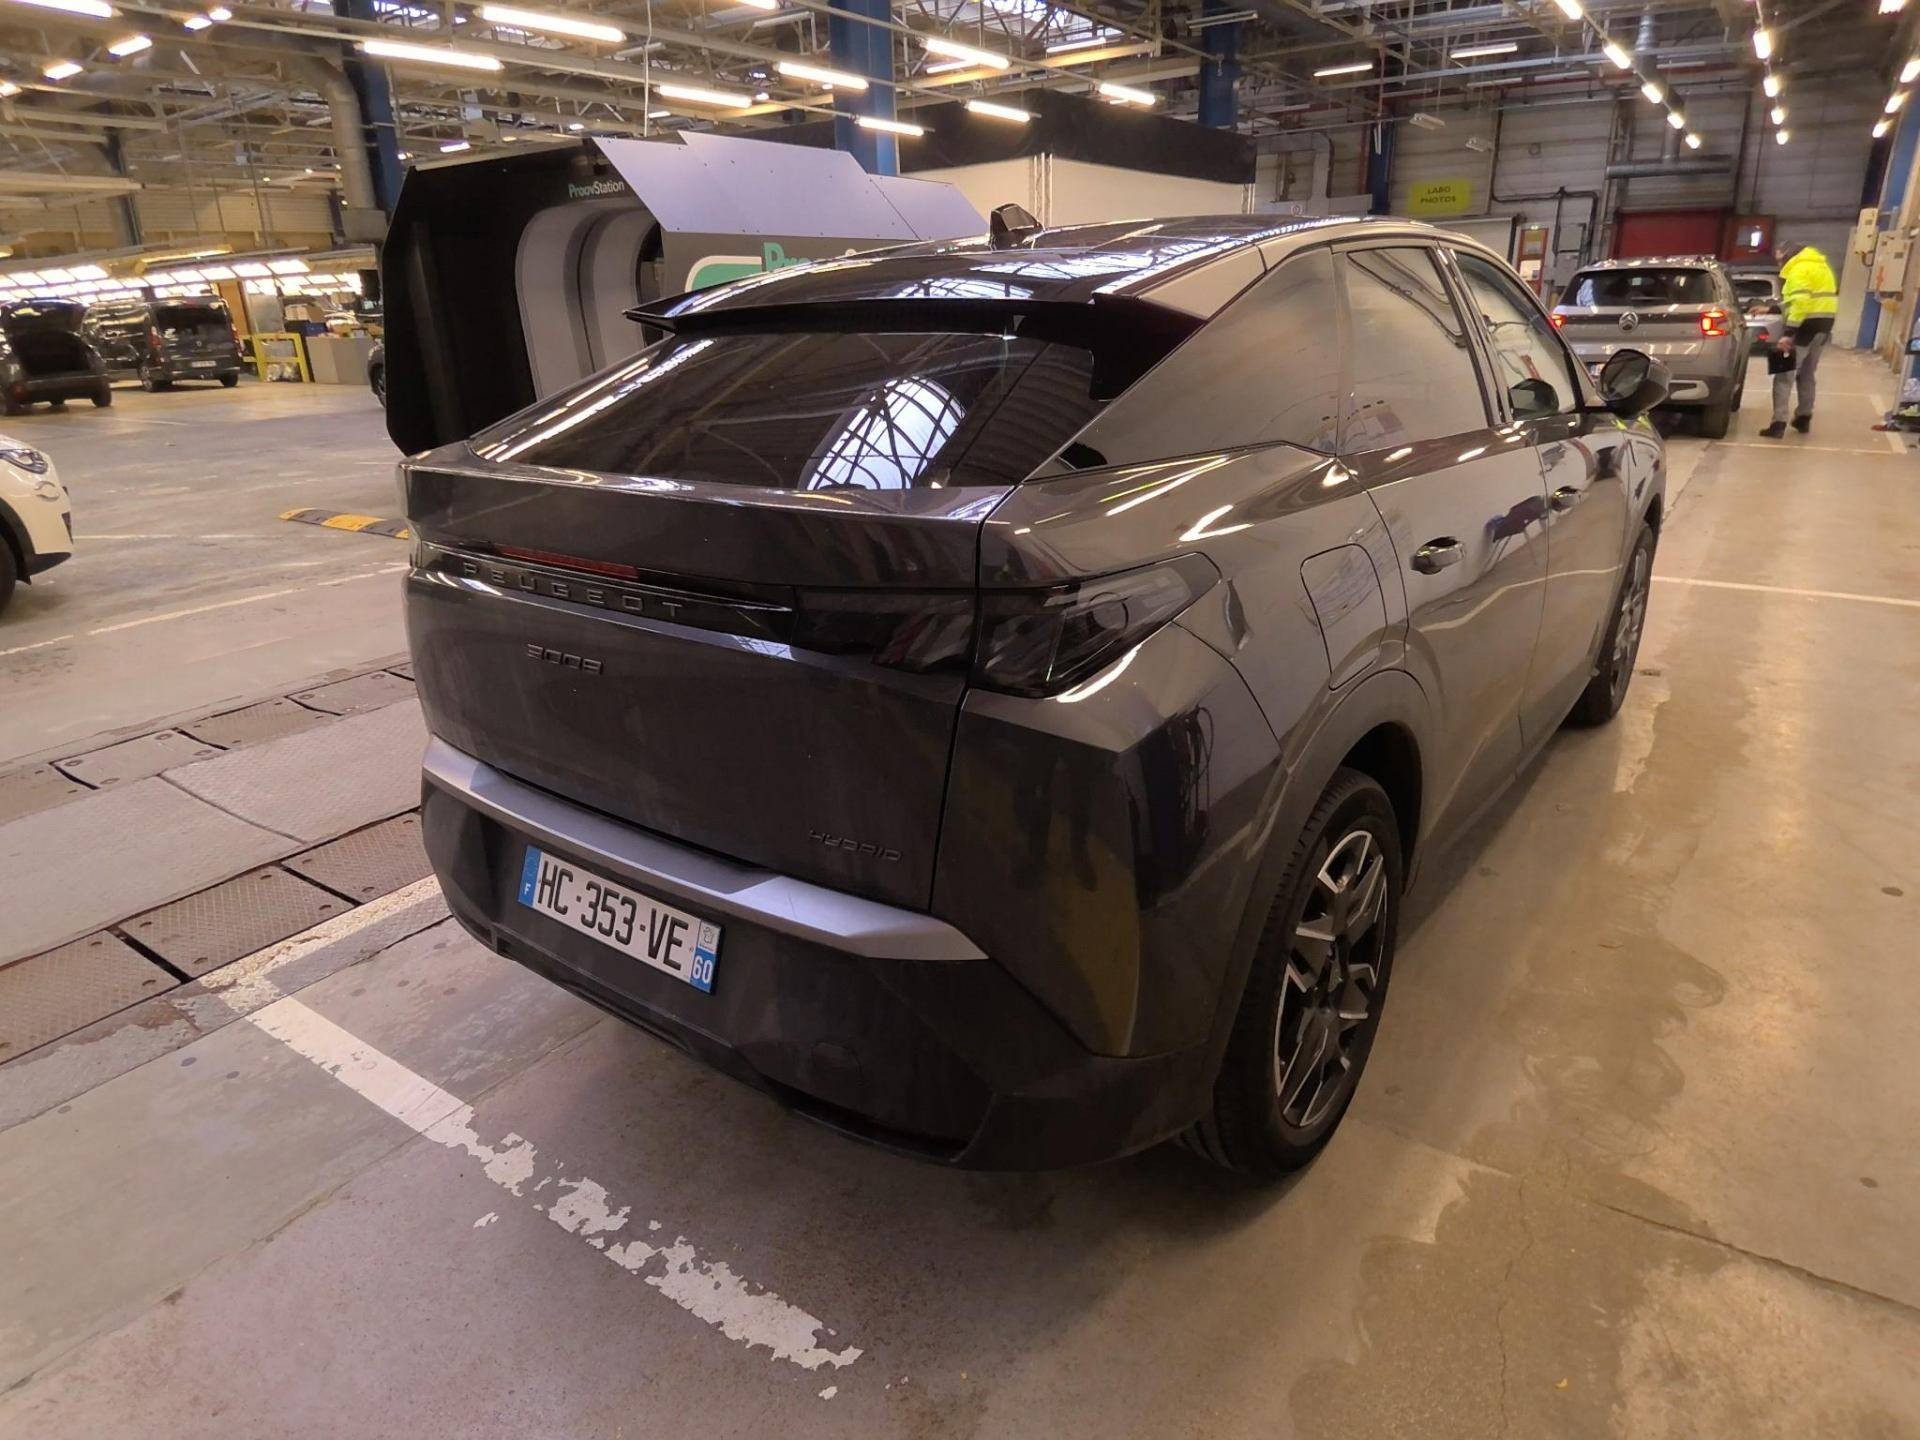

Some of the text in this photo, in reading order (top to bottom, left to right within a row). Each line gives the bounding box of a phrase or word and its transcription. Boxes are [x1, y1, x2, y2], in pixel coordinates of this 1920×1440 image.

[463, 561, 682, 617] PEUGEOT
[527, 643, 603, 674] 3008
[809, 829, 902, 861] HYBRID
[692, 955, 713, 984] 60
